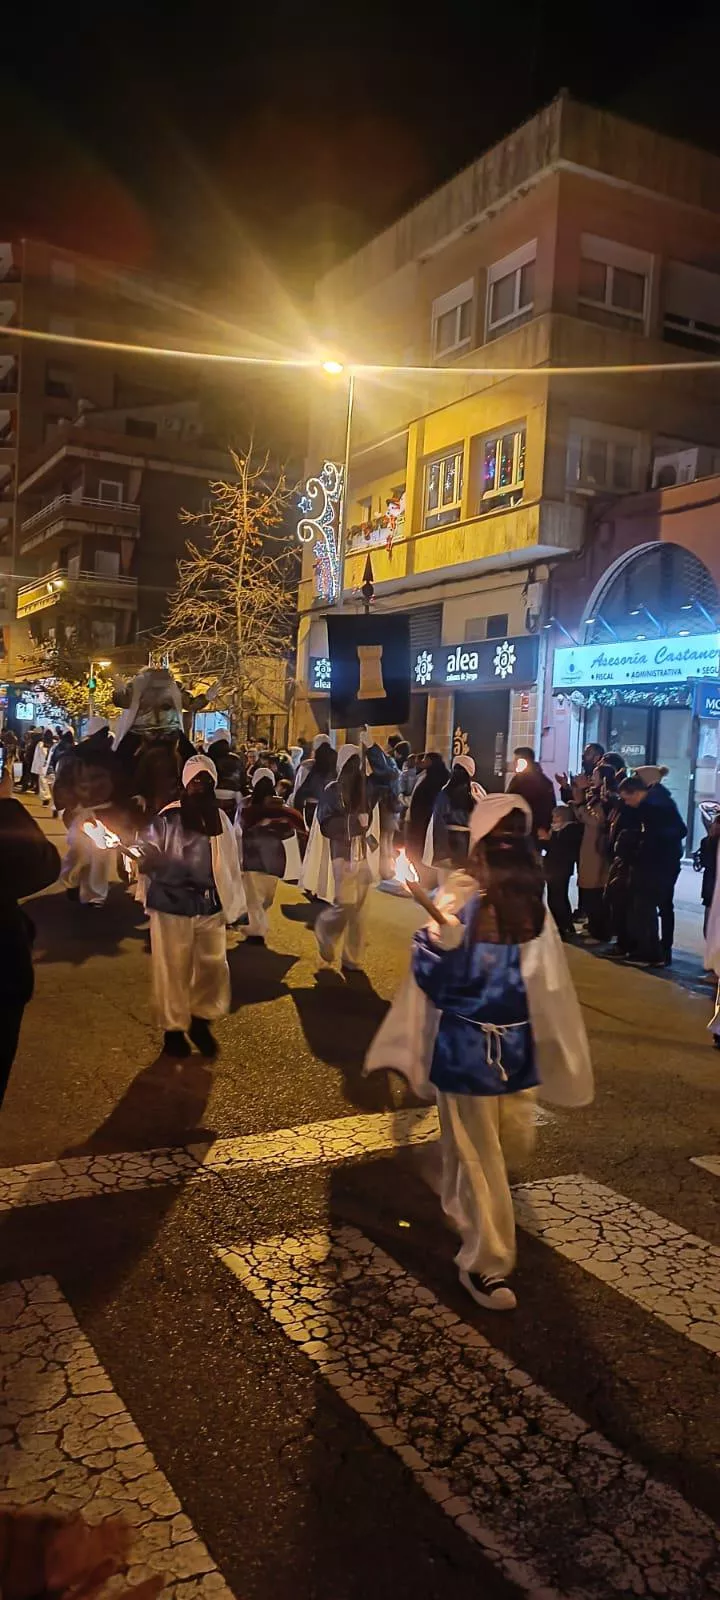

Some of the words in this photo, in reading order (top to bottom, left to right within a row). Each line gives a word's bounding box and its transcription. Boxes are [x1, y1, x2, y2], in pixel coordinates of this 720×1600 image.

[447, 647, 479, 672] alea
[590, 653, 648, 668] Asesoría
[631, 668, 682, 678] ADMINISTRATIVA
[314, 678, 331, 689] alea
